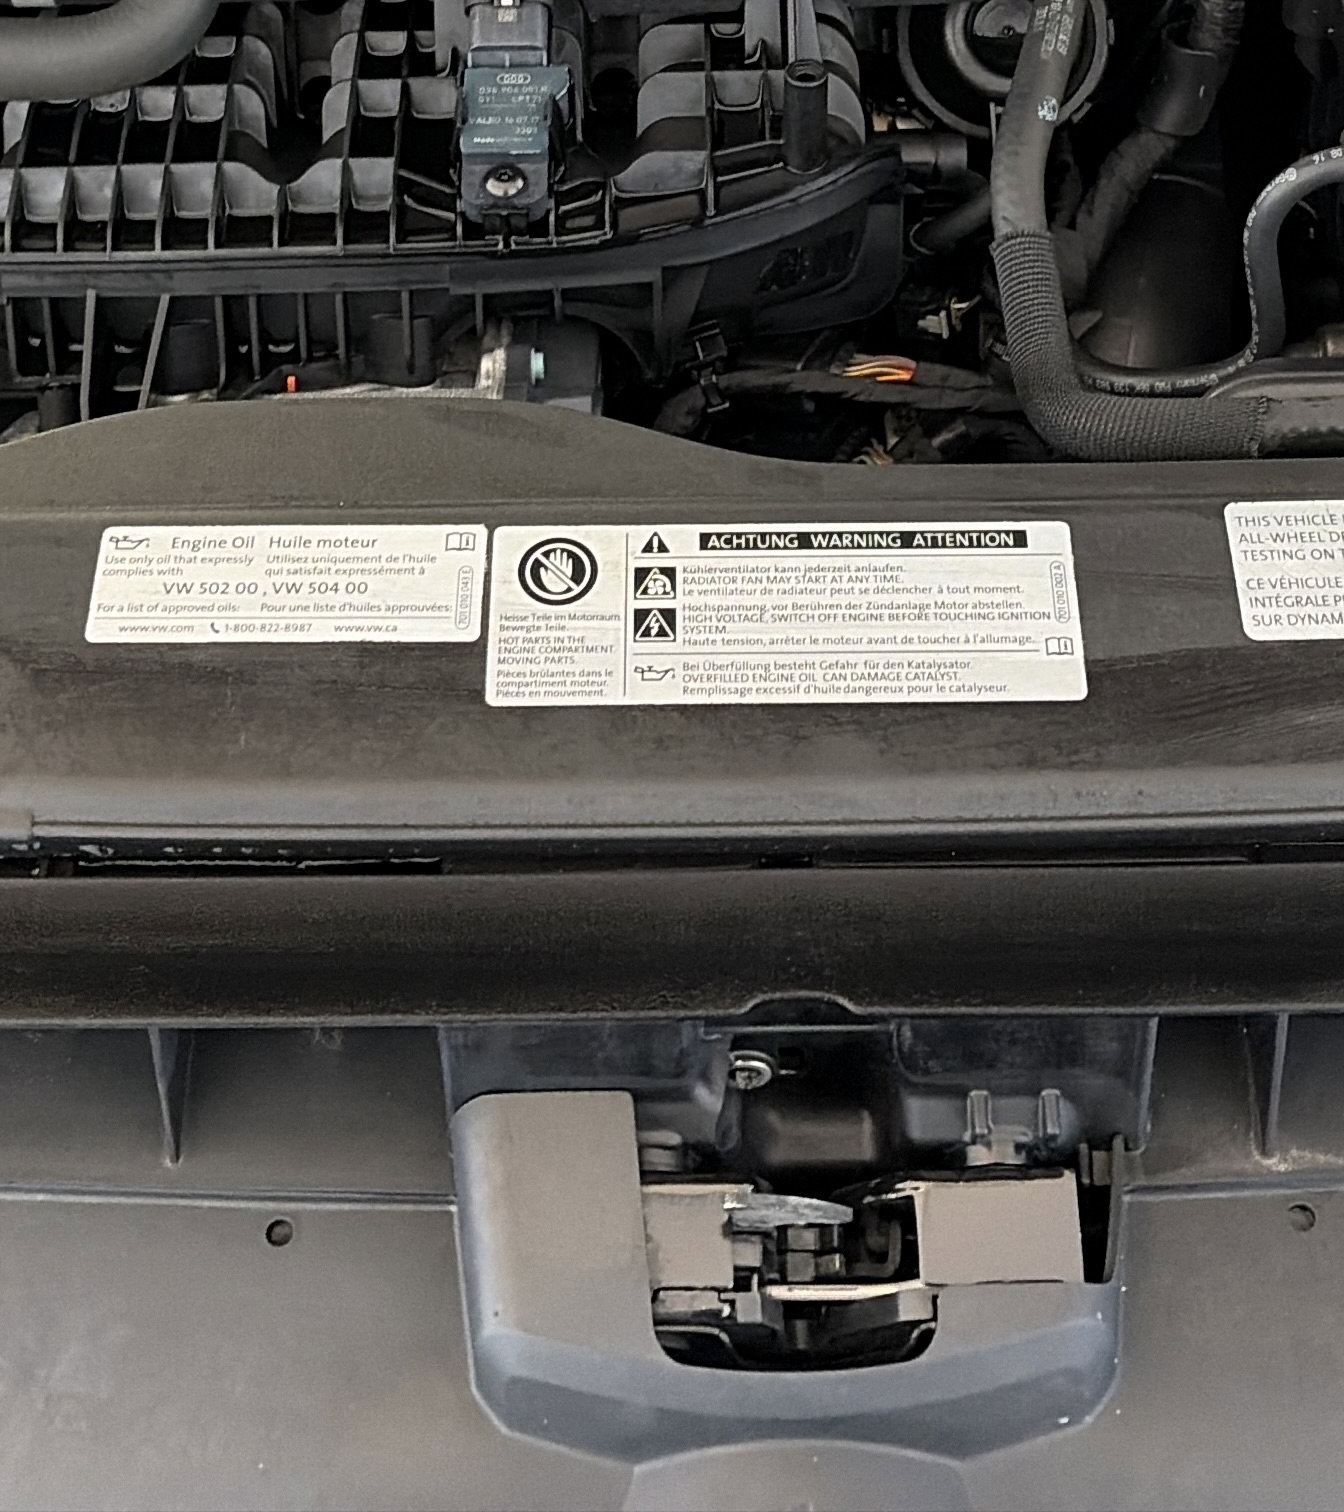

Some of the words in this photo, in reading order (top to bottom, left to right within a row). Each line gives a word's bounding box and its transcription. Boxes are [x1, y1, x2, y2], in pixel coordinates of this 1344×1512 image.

[1236, 515, 1270, 527] THIS
[1273, 514, 1337, 526] VEHICLE
[269, 536, 311, 549] Huile
[317, 537, 377, 549] moteur
[707, 534, 799, 549] ACHTUNG
[810, 534, 901, 547] WARNING
[913, 532, 1014, 547] ATTENTION
[1239, 531, 1325, 544] ALL-WHEEL
[172, 537, 227, 552] Engine
[232, 536, 254, 548] Oil
[129, 556, 154, 566] only
[174, 555, 197, 564] that
[201, 555, 254, 566] expressly
[266, 554, 308, 563] Utilisez
[312, 554, 382, 567] uniquement
[1240, 549, 1305, 562] TESTING
[1310, 549, 1335, 560] ON
[103, 568, 154, 577] complies
[157, 567, 183, 576] with
[286, 567, 331, 576] satisfait
[335, 567, 410, 578] expressément
[682, 576, 737, 585] RADIATOR
[795, 575, 827, 584] START
[1268, 575, 1343, 590] VÉHICULE
[163, 582, 194, 595] VW
[199, 582, 229, 595] 502
[235, 582, 258, 595] 00
[273, 582, 303, 594] VW
[308, 582, 340, 594] 504
[345, 582, 368, 594] 00
[697, 587, 757, 596] ventilateur
[260, 603, 286, 612] Pour
[313, 602, 335, 612] liste
[935, 601, 968, 610] Motor
[1249, 594, 1330, 608] INTÉGRALE
[161, 603, 214, 614] approved
[682, 614, 712, 623] HIGH
[842, 613, 884, 622] ENGINE
[934, 612, 995, 621] TOUCHING
[1253, 614, 1281, 627] SUR
[225, 623, 312, 632] 1-800-822-8987
[918, 635, 960, 644] toucher
[703, 660, 770, 672] Überfüllung
[682, 674, 749, 683] OVERFILLED
[823, 672, 847, 682] CAN
[851, 672, 902, 681] DAMAGE
[682, 685, 753, 697] Remplissage
